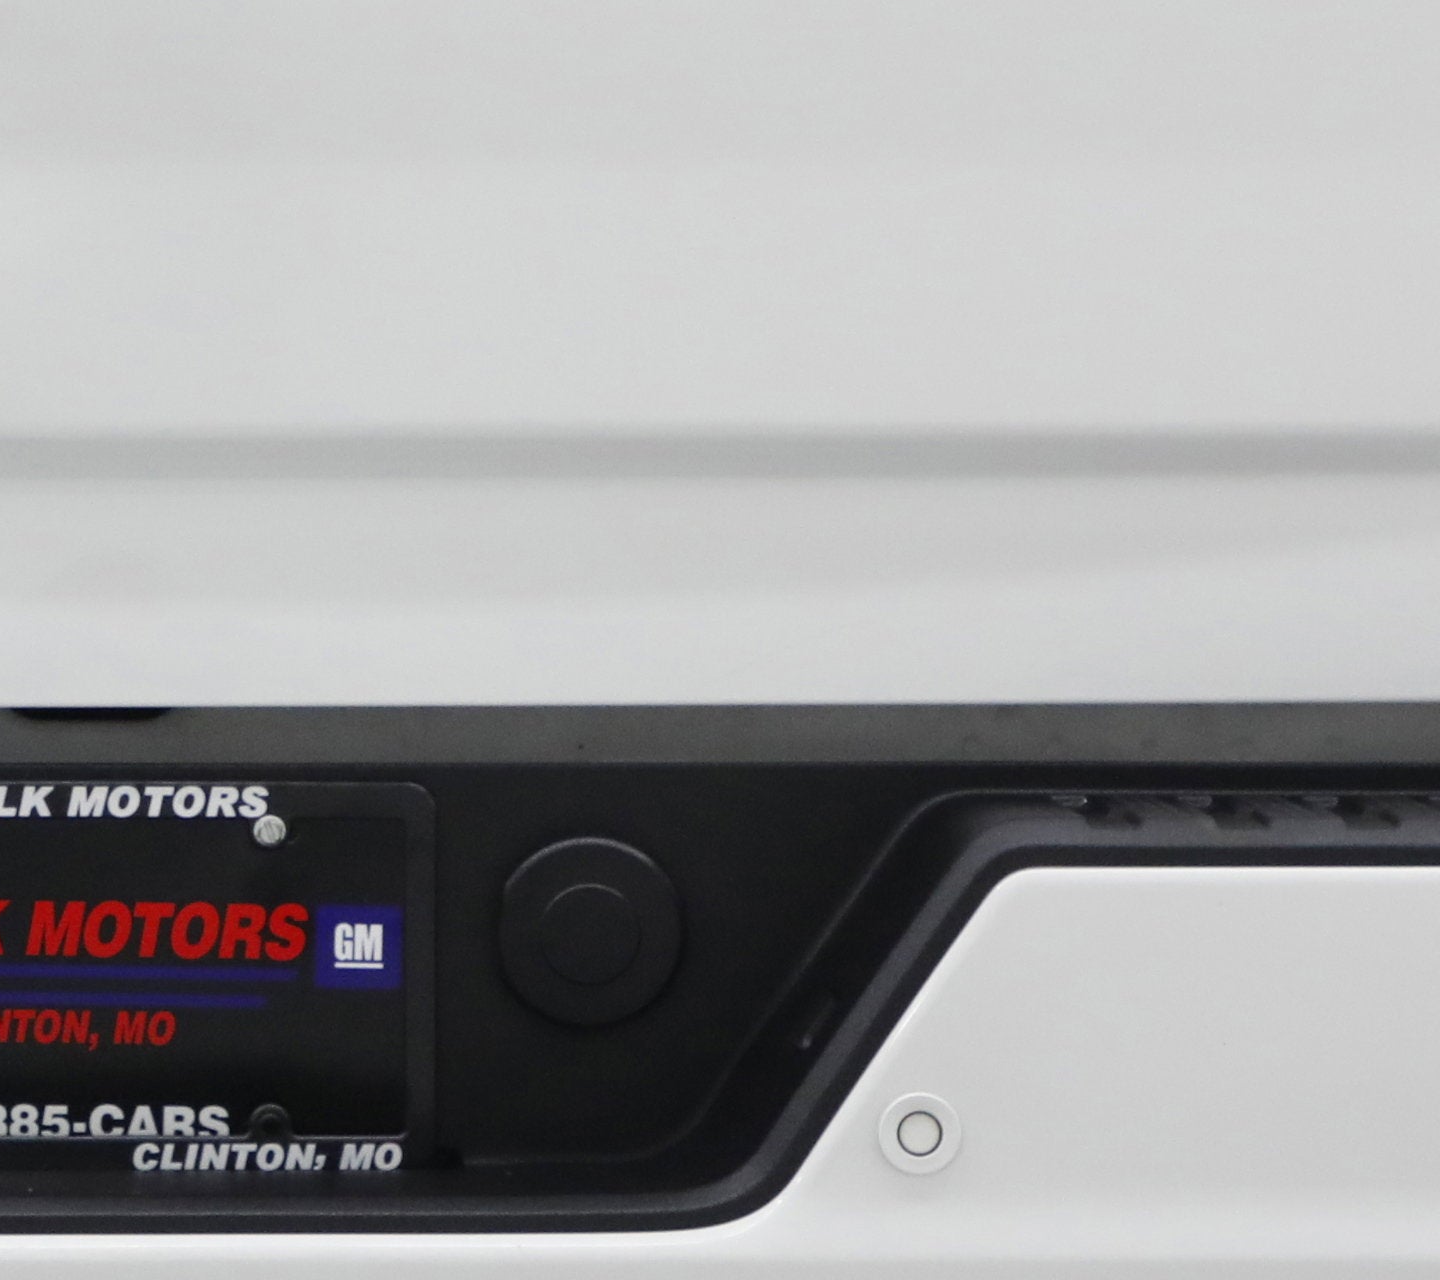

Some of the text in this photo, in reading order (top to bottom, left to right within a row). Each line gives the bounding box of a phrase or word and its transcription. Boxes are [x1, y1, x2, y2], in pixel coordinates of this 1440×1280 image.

[67, 785, 269, 818] MOTORS
[25, 900, 309, 961] MOTORS
[333, 923, 384, 962] GM
[113, 1010, 177, 1046] MO
[132, 1142, 404, 1171] CLINTON, MO
